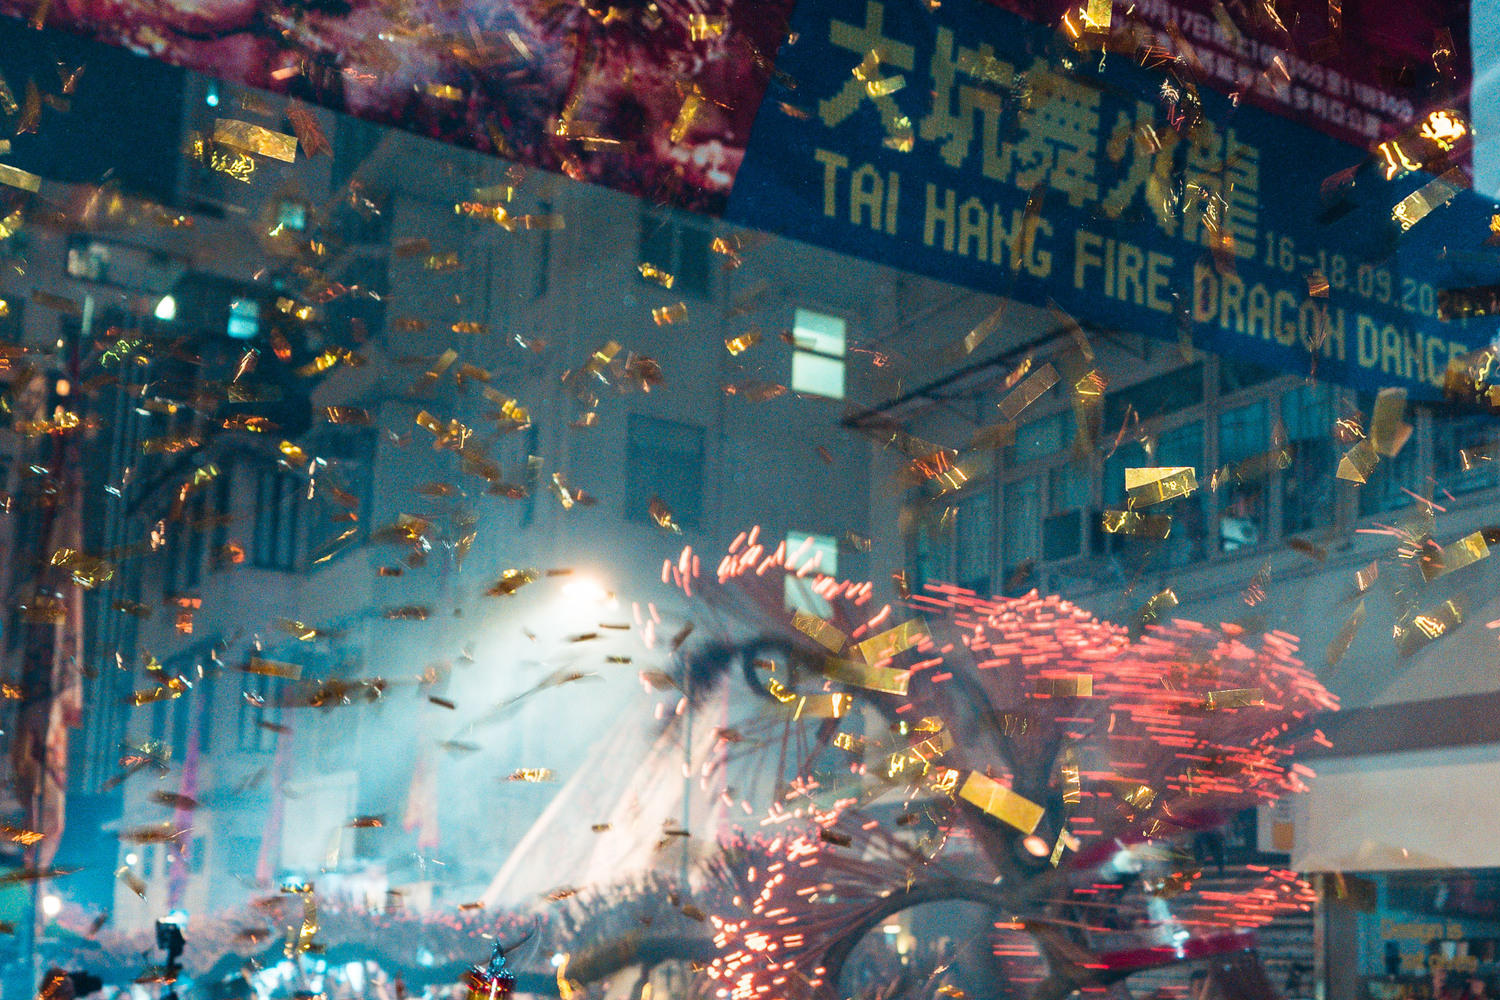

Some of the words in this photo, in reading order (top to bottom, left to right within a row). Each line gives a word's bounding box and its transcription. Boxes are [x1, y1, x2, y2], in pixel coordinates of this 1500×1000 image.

[814, 148, 900, 236] TAI
[924, 183, 1053, 278] HANG
[1074, 229, 1174, 313] FIRE
[1193, 261, 1345, 362] DRAGON
[1264, 231, 1466, 326] 16-18.09.20
